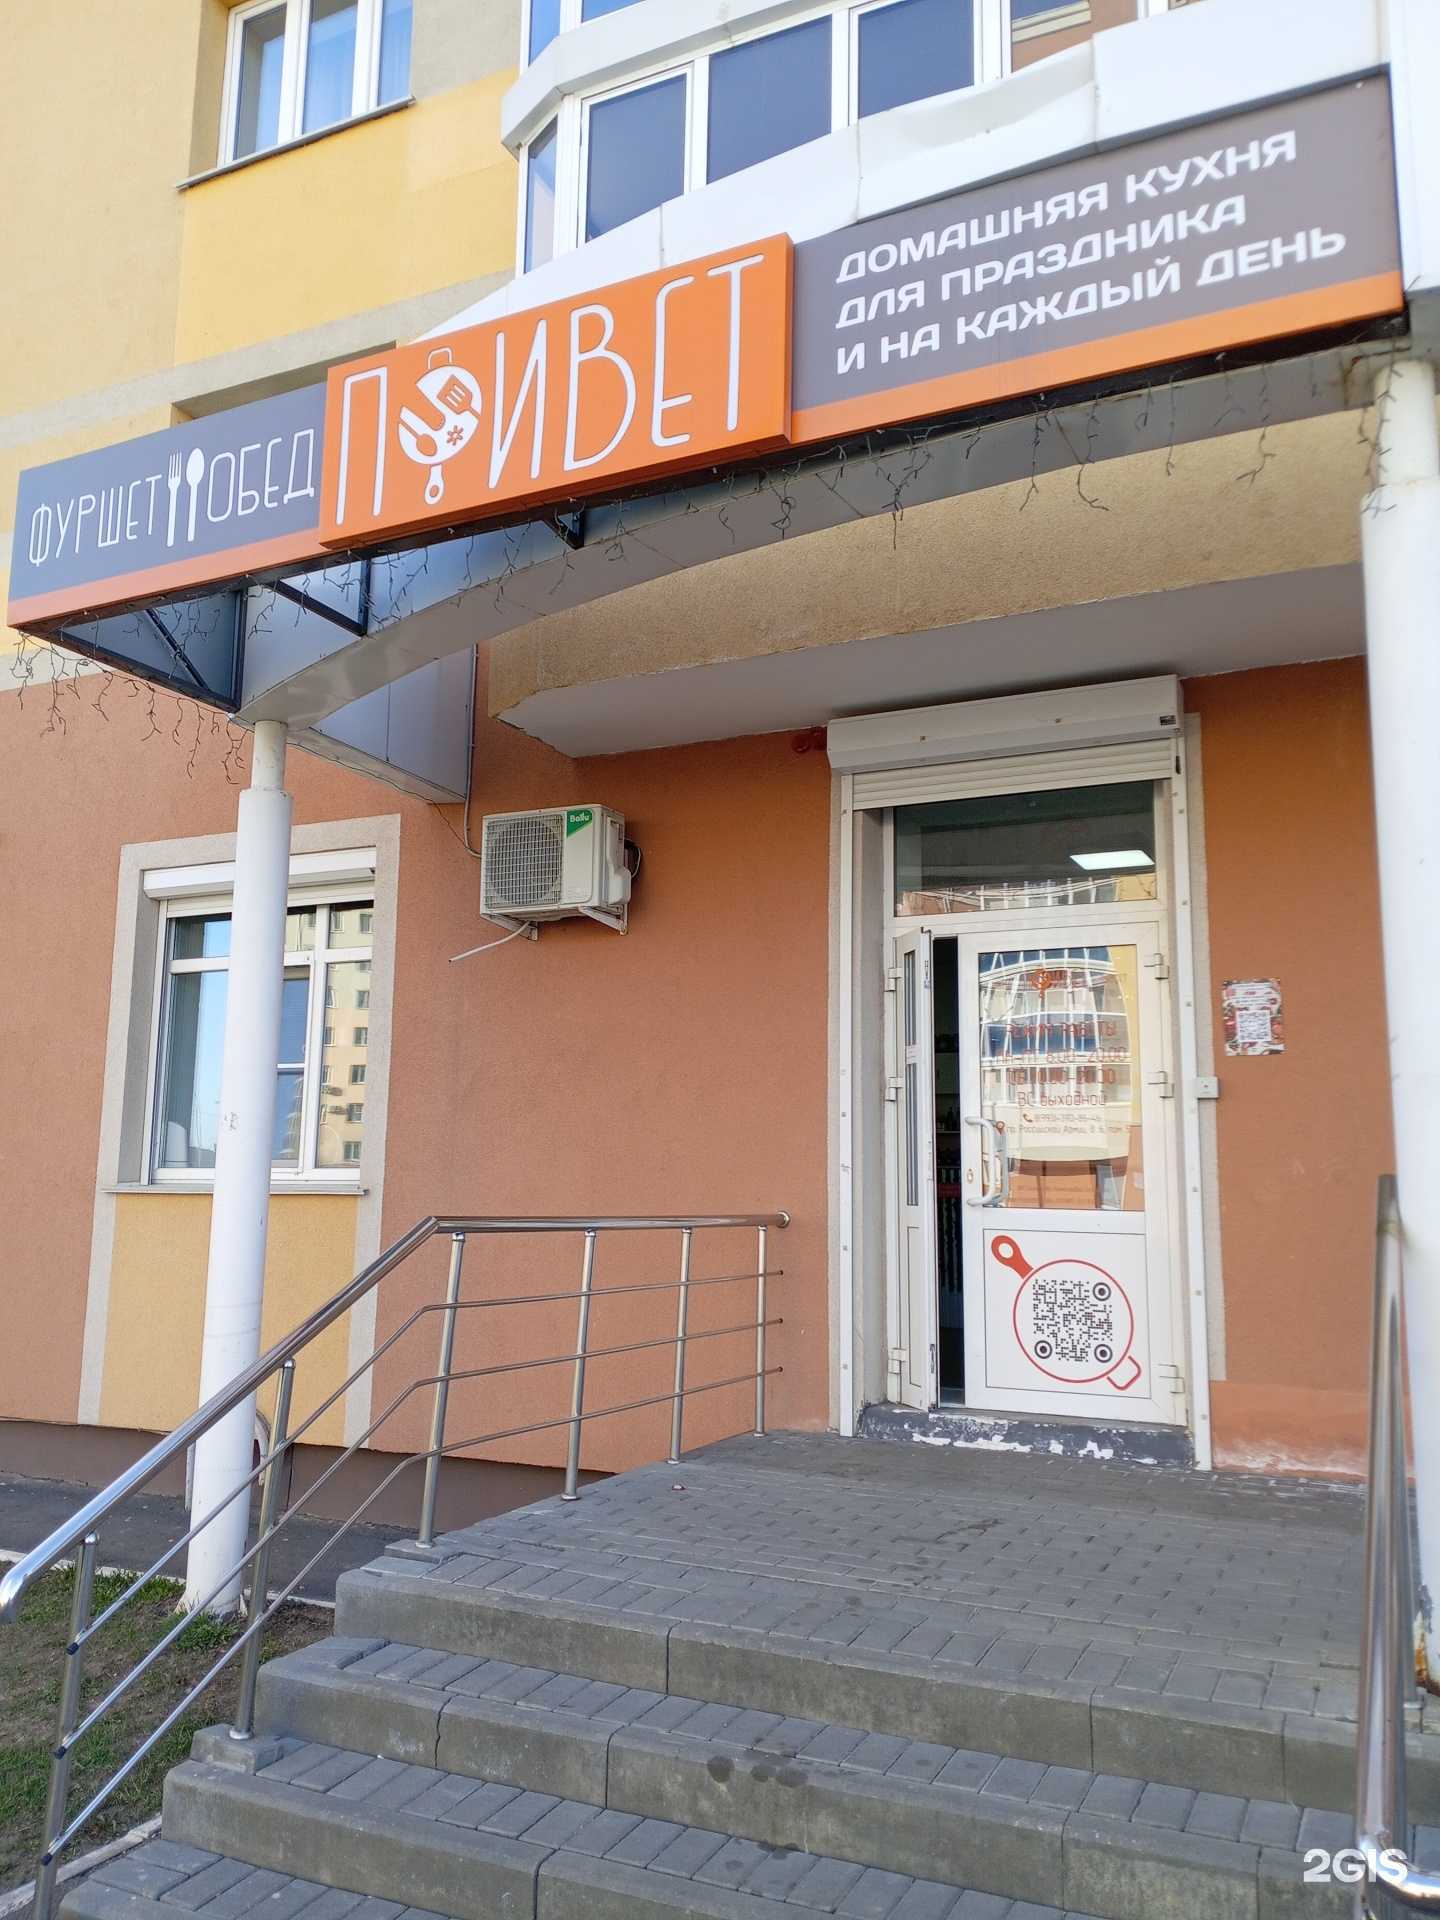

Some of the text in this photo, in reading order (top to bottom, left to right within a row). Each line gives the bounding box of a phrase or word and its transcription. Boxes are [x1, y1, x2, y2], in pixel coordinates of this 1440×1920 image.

[835, 130, 1297, 285] ДОМАШНЯЯ КУХНЯ
[835, 194, 1247, 329] ДЛЯ ПРАЗДНИКА
[836, 227, 1347, 375] И НА КАЖДЫЙ ДЕНЬ
[28, 428, 315, 568] ФУРШЕТ ОБЕД
[1061, 1019, 1117, 1037] РАБТЫ
